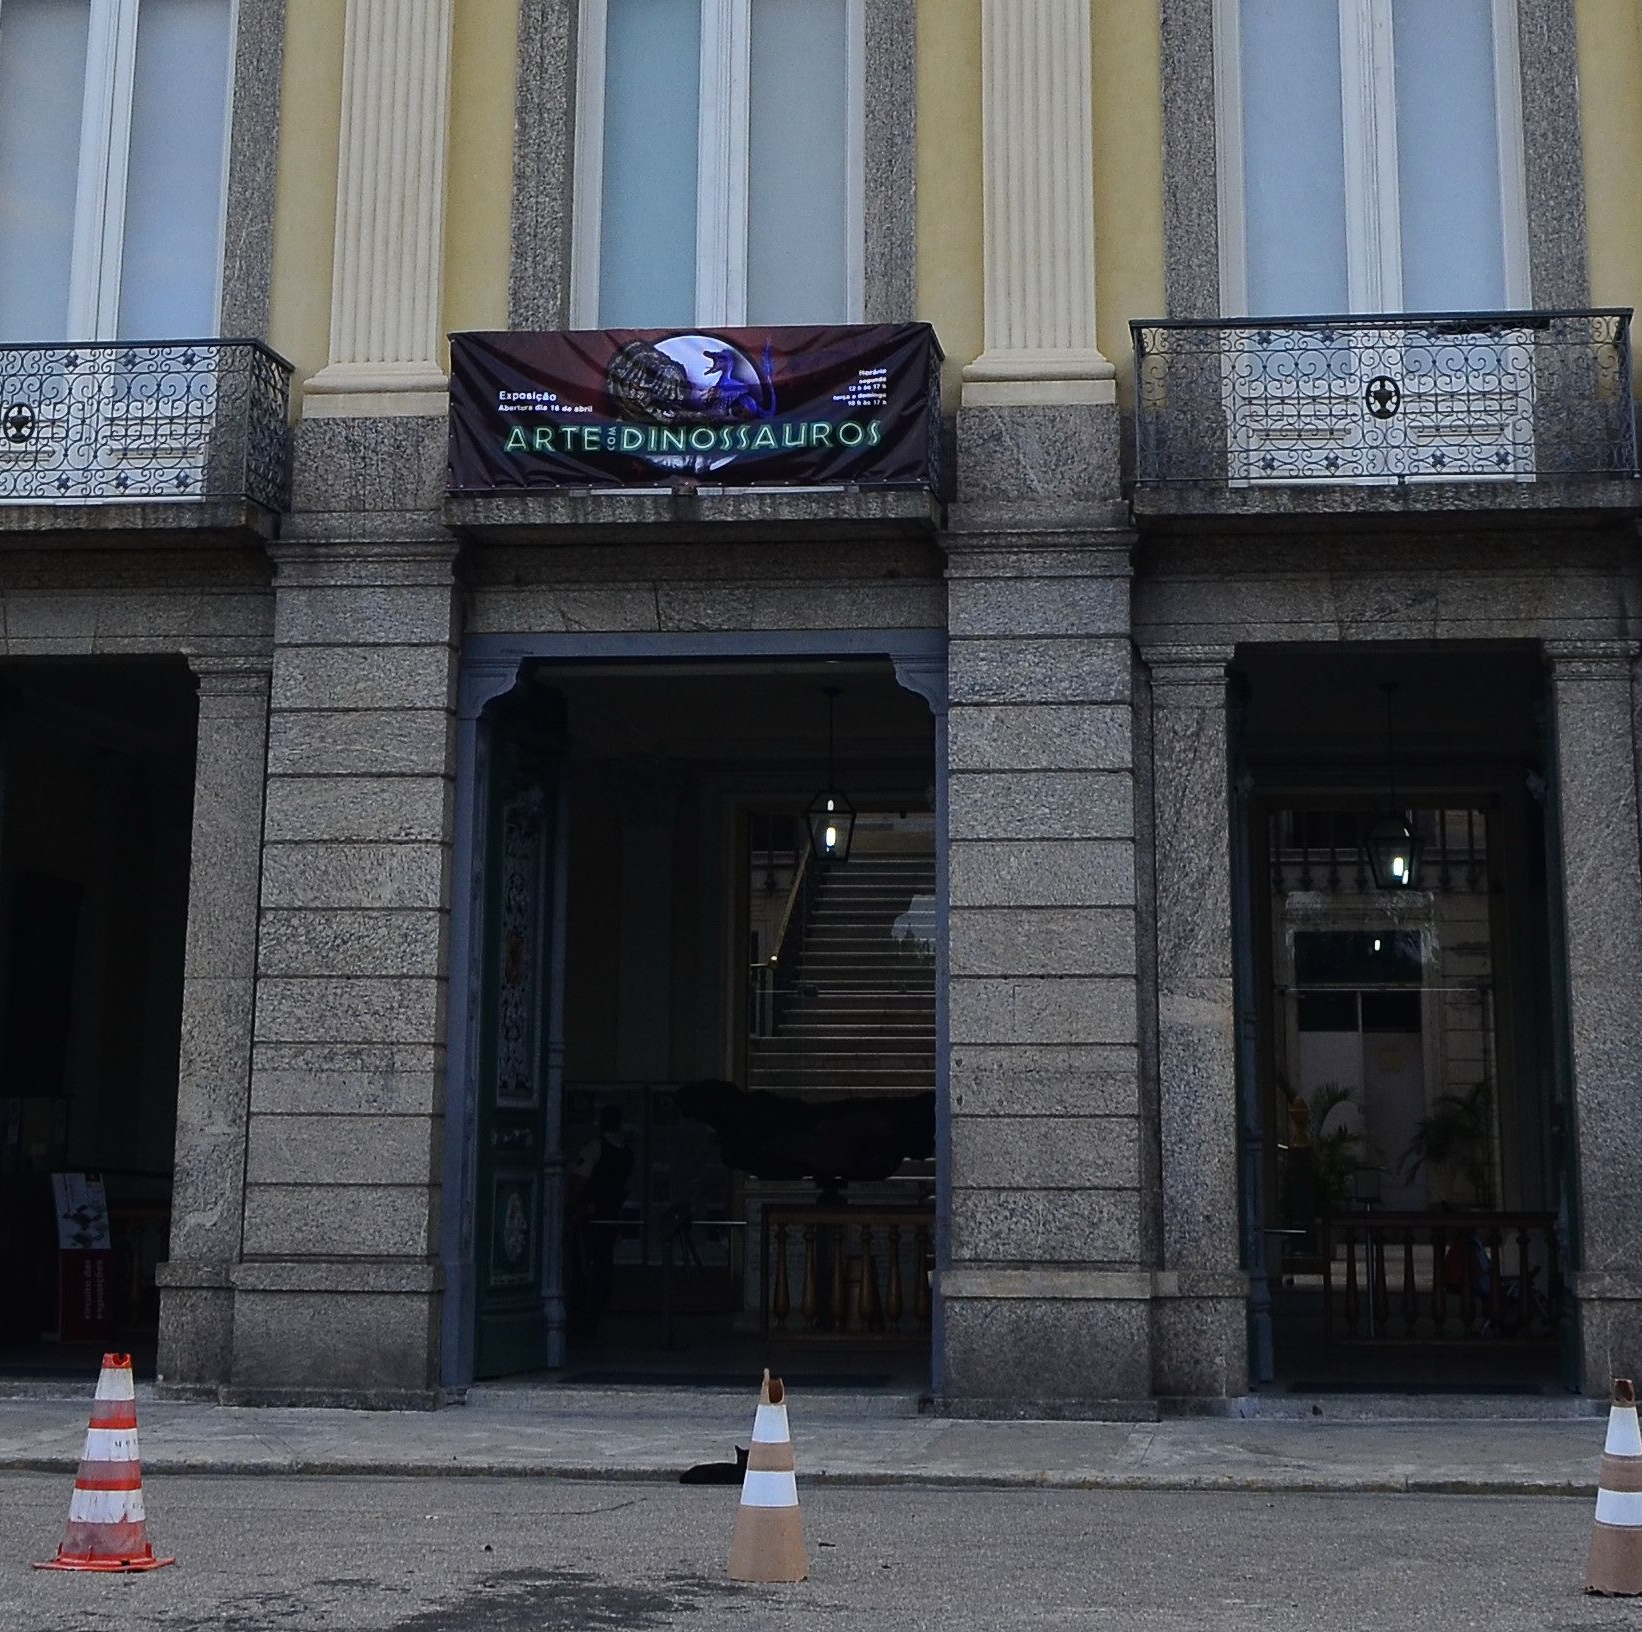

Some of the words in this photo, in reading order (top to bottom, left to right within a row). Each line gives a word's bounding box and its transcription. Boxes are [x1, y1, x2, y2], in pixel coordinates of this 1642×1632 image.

[499, 391, 557, 402] Exposição
[504, 425, 601, 452] ARTE
[607, 427, 616, 451] COM
[620, 420, 882, 451] DINOSSAUROS
